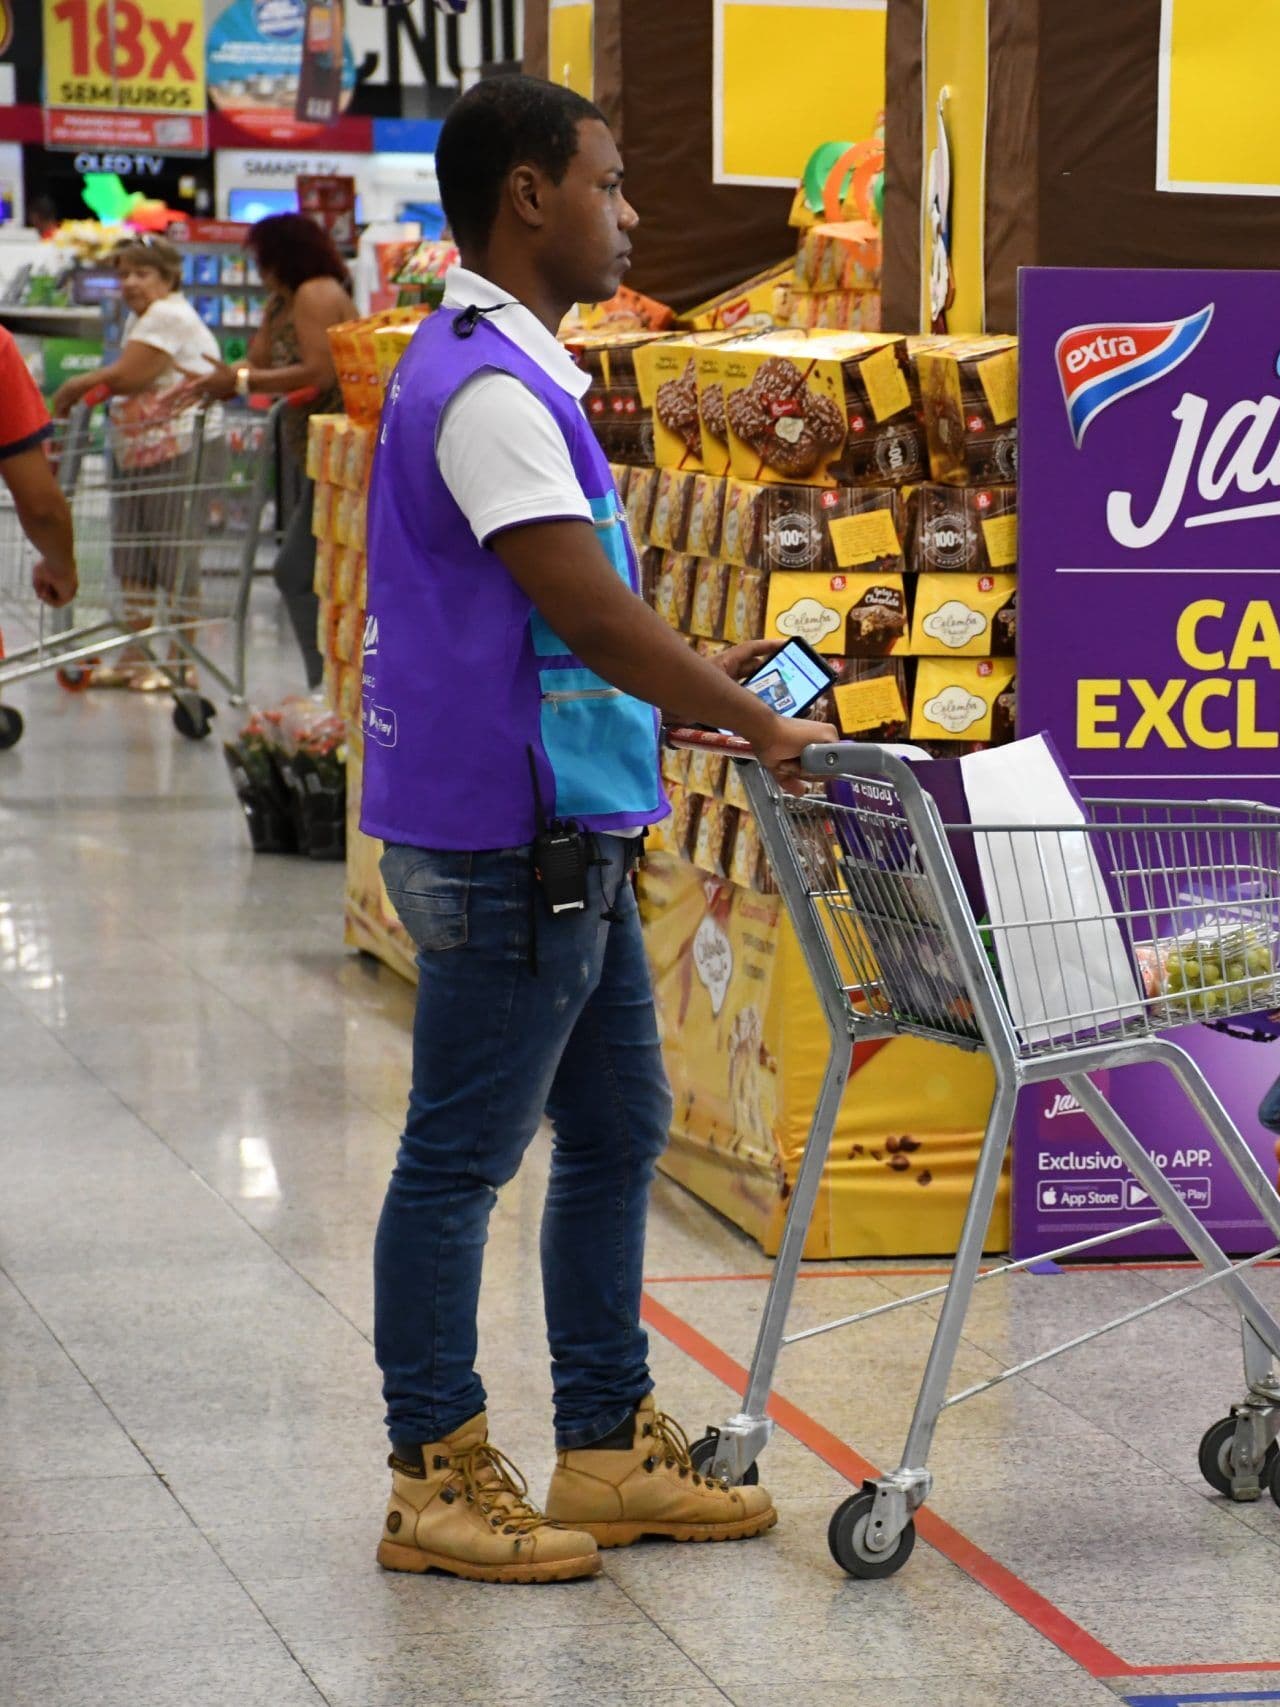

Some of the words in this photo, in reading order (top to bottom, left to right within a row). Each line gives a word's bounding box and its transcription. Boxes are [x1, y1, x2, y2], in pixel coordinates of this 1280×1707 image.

[53, 0, 196, 81] 18x
[61, 83, 112, 102] SEM
[118, 85, 192, 107] JUROS
[74, 153, 133, 174] OLED
[135, 154, 164, 175] TV
[1066, 335, 1137, 373] extra
[1038, 1151, 1123, 1171] Exclusivo
[1172, 1149, 1213, 1168] APP.
[1060, 1192, 1087, 1206] App
[1088, 1192, 1119, 1204] Store
[1187, 1188, 1208, 1201] Play
